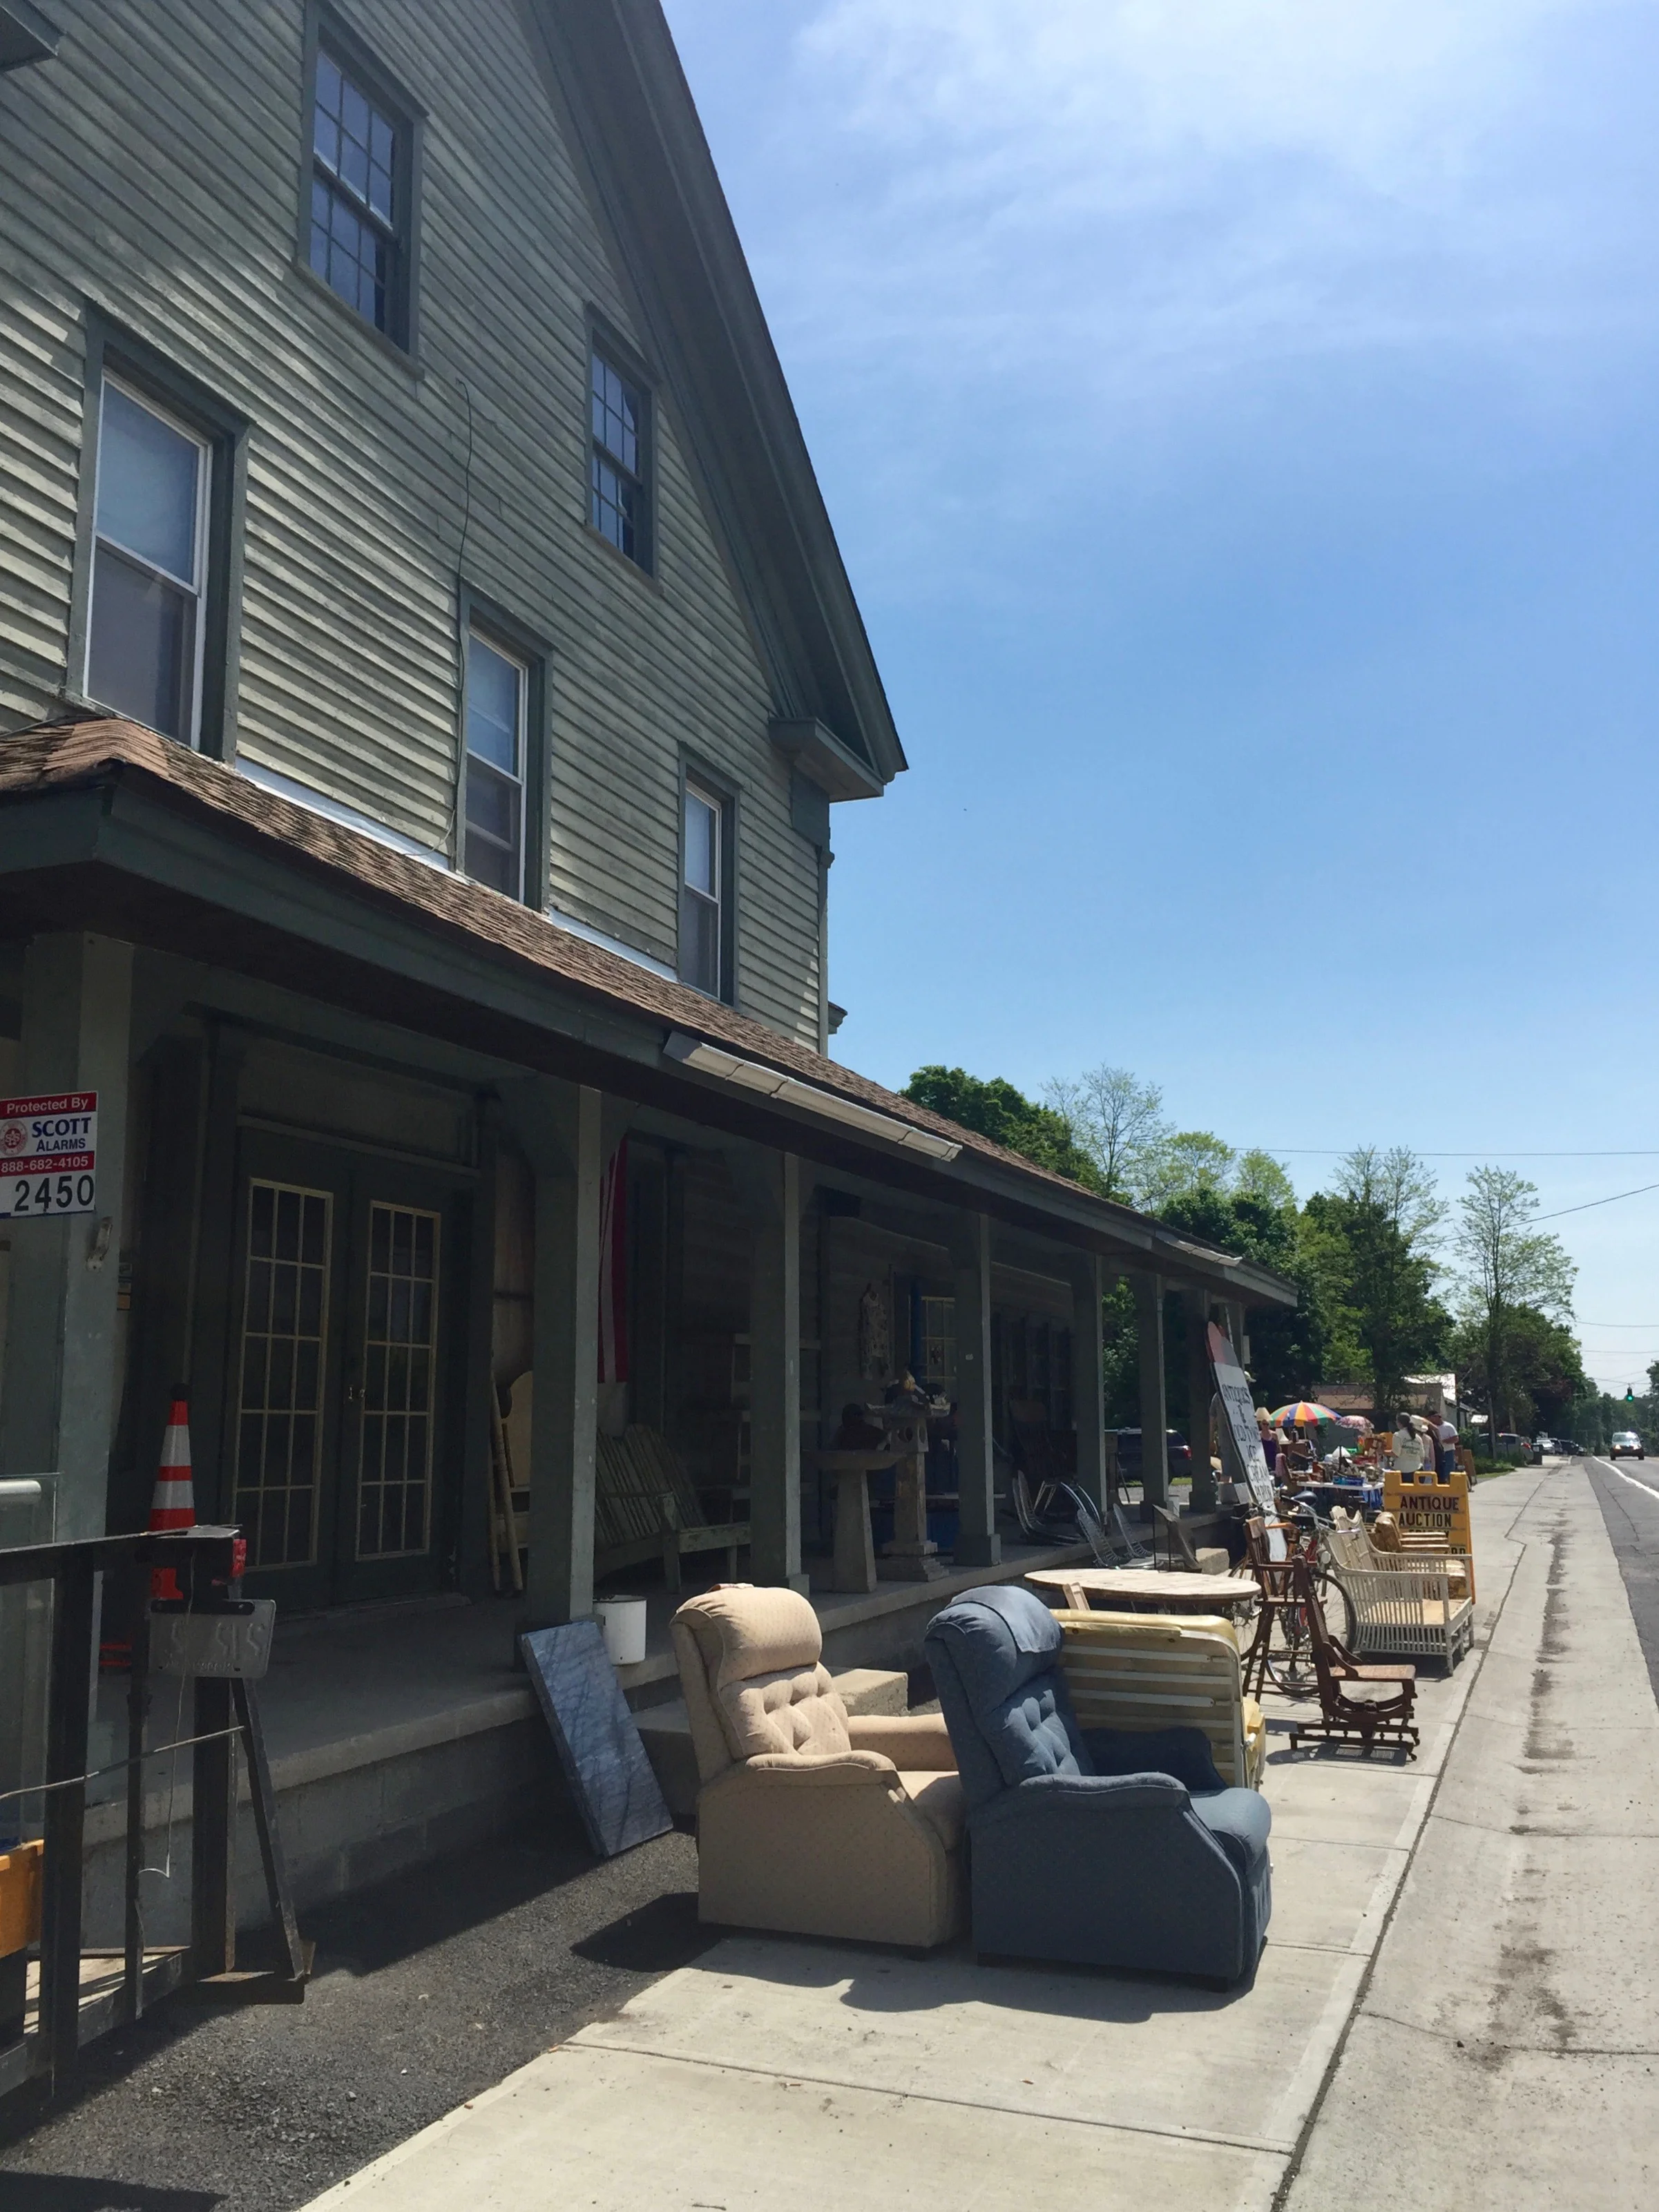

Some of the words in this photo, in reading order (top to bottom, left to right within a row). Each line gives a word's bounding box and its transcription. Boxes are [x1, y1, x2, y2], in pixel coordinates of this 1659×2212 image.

[7, 1100, 67, 1114] Protected
[71, 1097, 88, 1110] By
[32, 1117, 91, 1137] SCOTT
[36, 1138, 86, 1153] ALARMS
[1, 1156, 88, 1173] 888-682-4105
[15, 1175, 94, 1212] 2450
[1222, 1384, 1251, 1405] ANTIQUES
[1247, 1445, 1260, 1461] ICE
[1400, 1495, 1459, 1510] ANTIQUE
[1399, 1512, 1452, 1527] AUCTION
